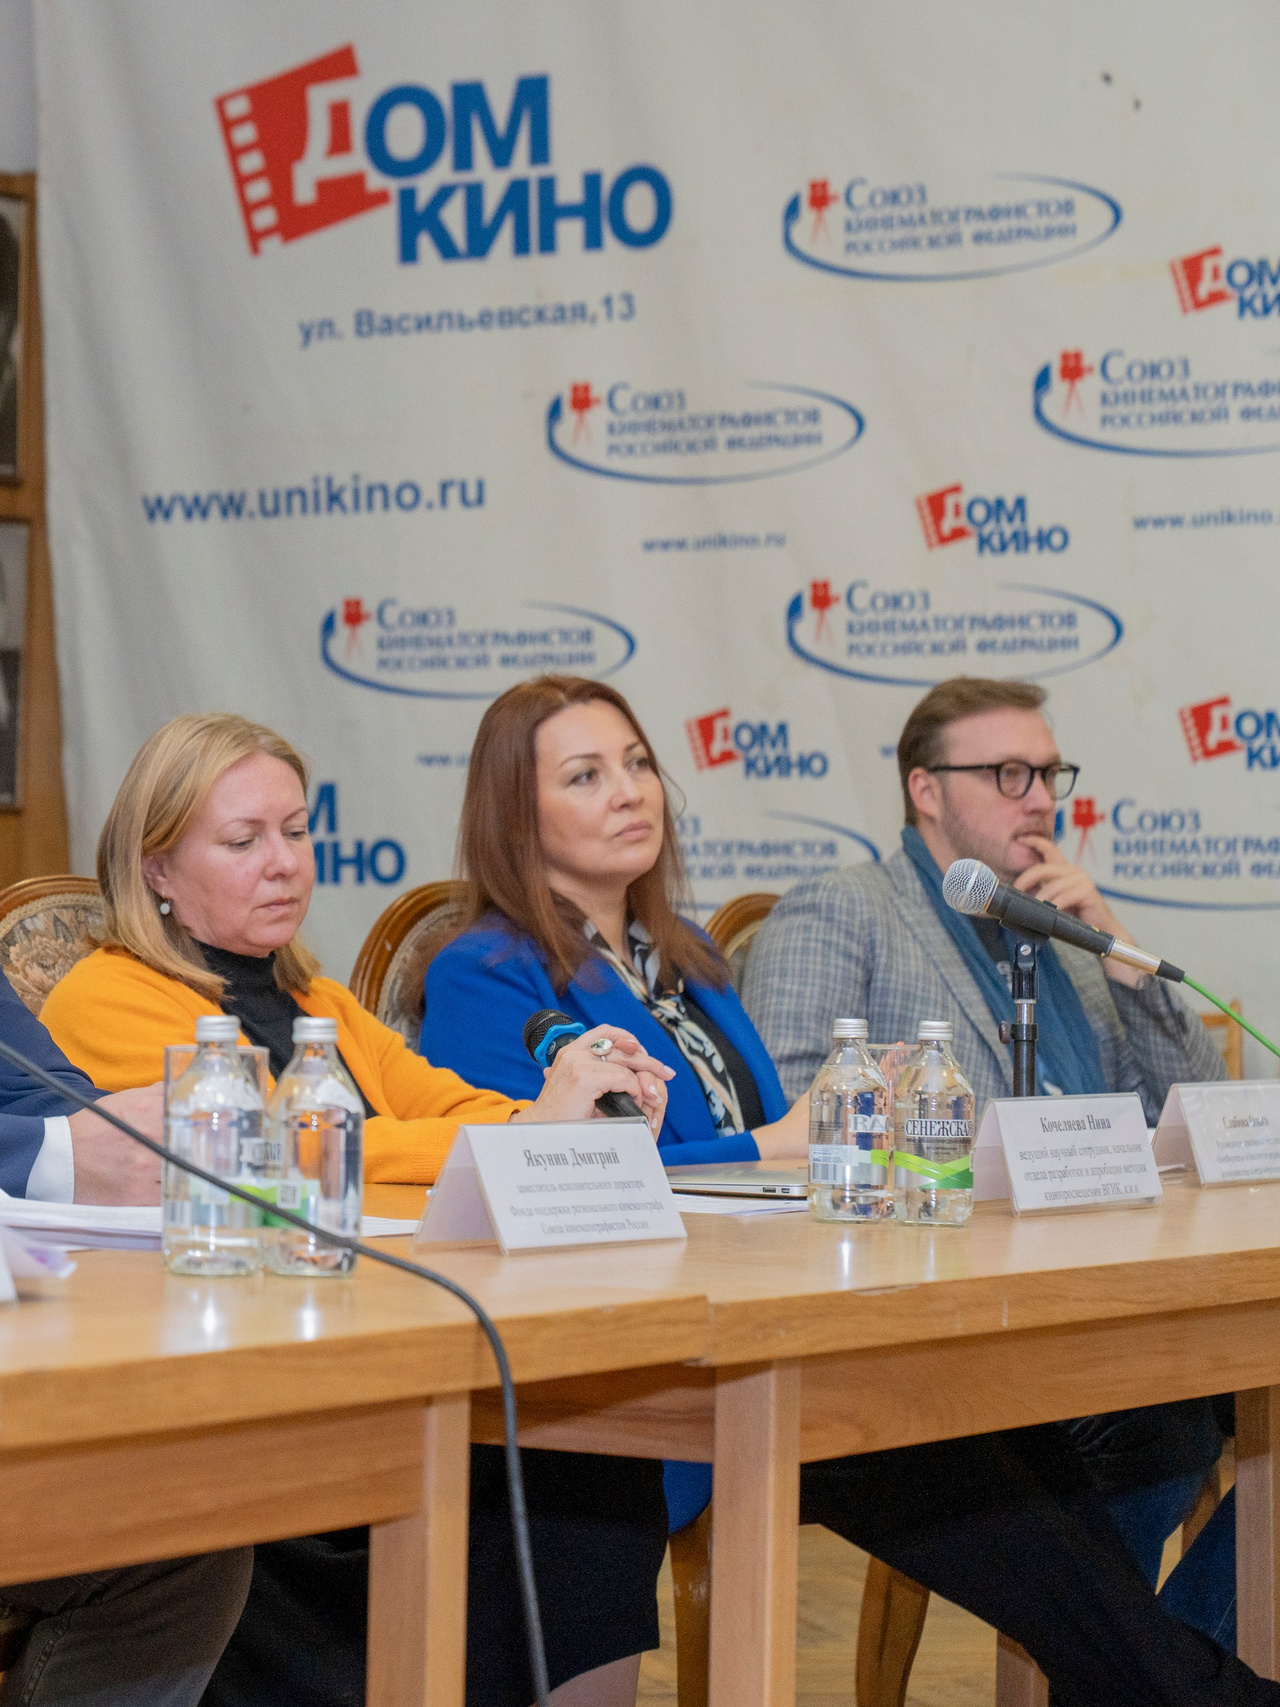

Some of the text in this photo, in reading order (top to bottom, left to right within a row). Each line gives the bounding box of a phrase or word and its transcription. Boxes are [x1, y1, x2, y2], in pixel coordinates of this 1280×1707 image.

[292, 72, 552, 206] ДОМ
[396, 162, 673, 266] КИНО
[299, 316, 344, 350] ул.
[142, 474, 486, 524] www.unikino.ru
[942, 495, 1027, 538] ДОМ
[641, 531, 787, 553] www.unikino.ru
[976, 525, 1070, 557] КИНО
[710, 720, 788, 760] ДОМ
[743, 751, 830, 779] КИНО
[1039, 1114, 1112, 1133] Кочеляева Нина
[523, 1146, 621, 1172] Якунин Дмитрий
[1019, 1147, 1050, 1163] ведущий
[1049, 1144, 1078, 1161] научный
[1024, 1170, 1049, 1182] отдела
[1048, 1165, 1084, 1182] разработки
